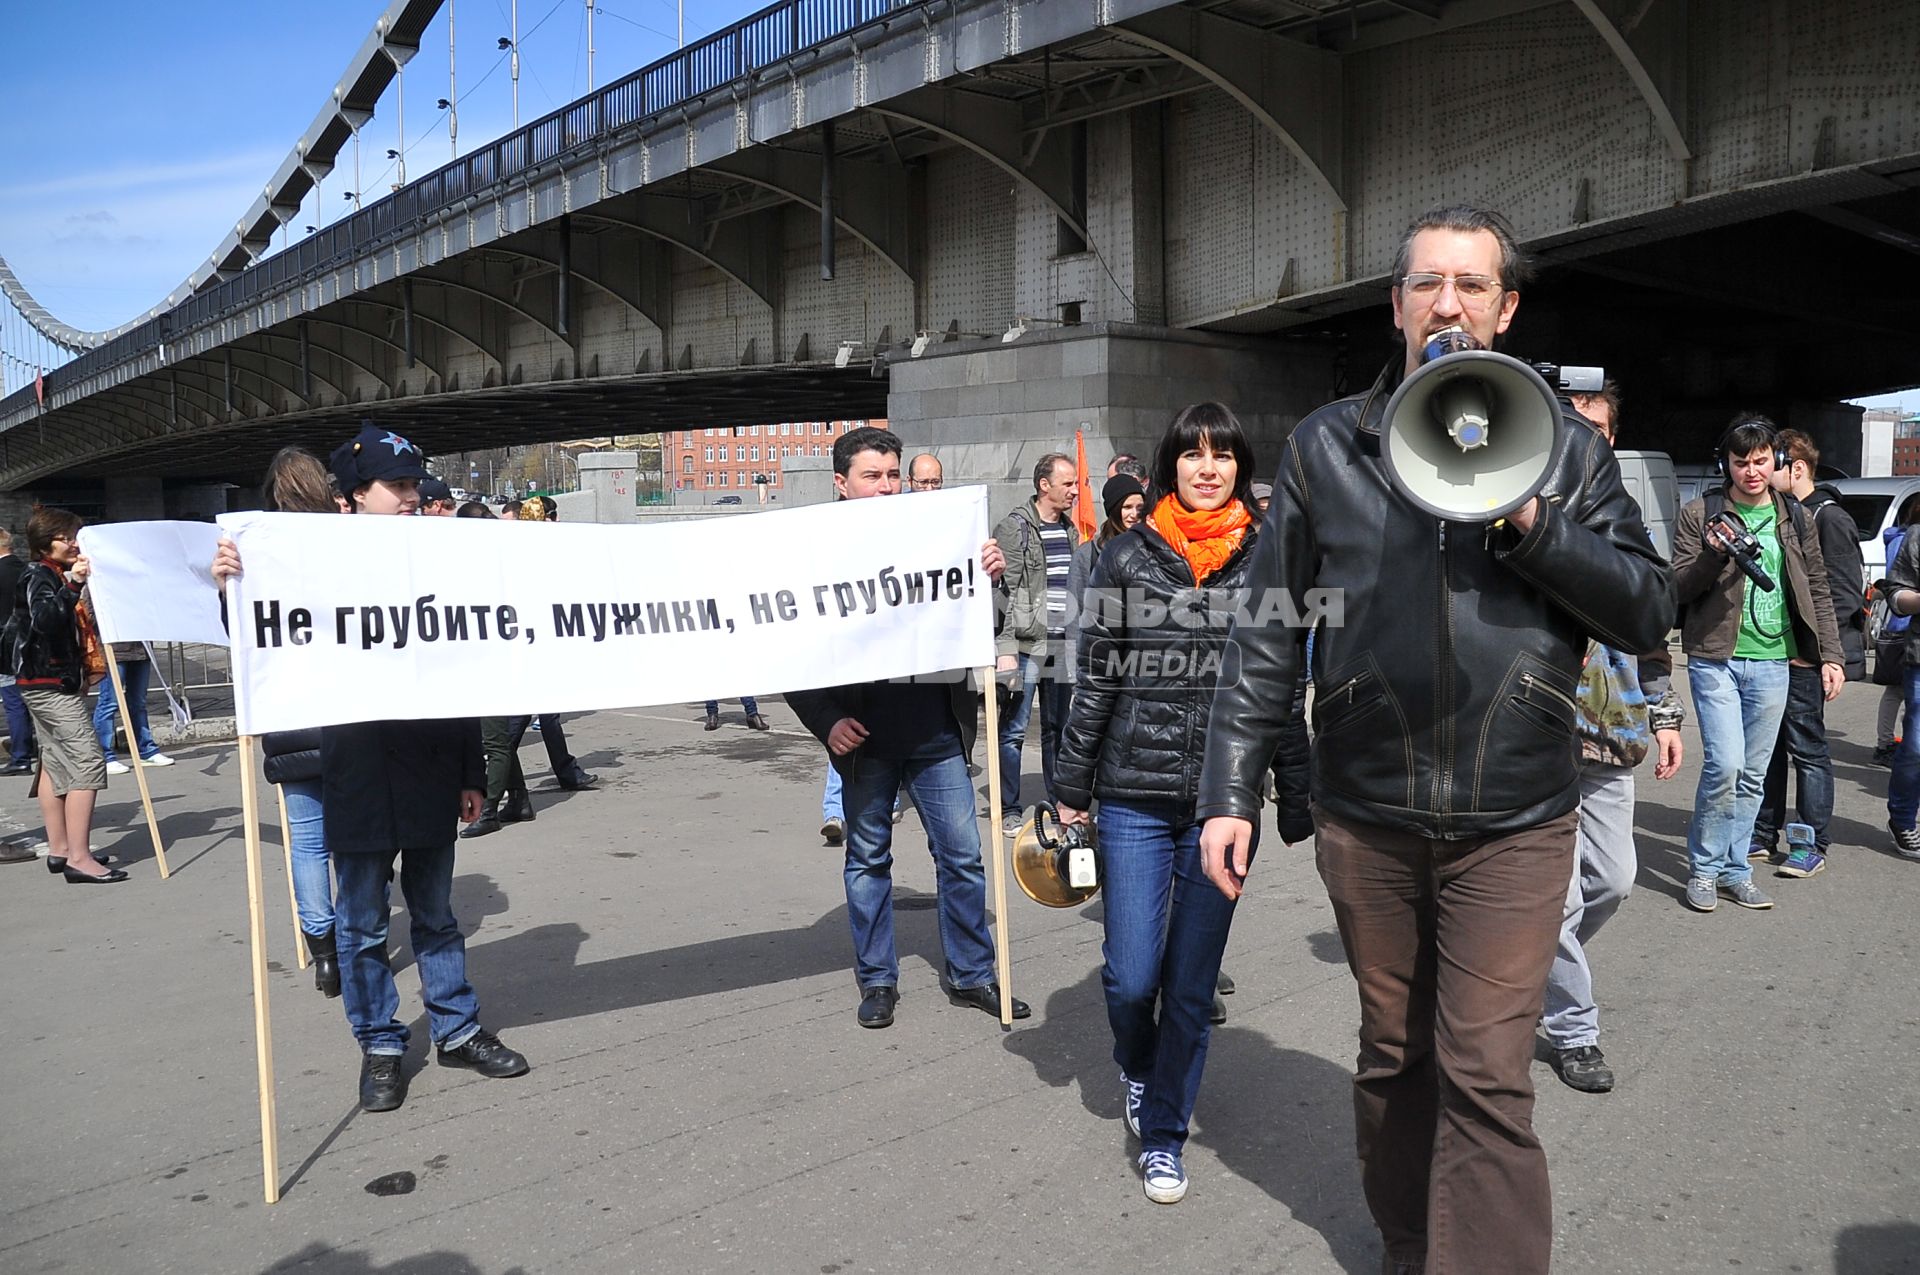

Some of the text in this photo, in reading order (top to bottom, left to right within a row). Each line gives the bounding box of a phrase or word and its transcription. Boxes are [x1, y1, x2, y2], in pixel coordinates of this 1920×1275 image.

[253, 558, 974, 651] Не грубите, мужики, не грубите!
